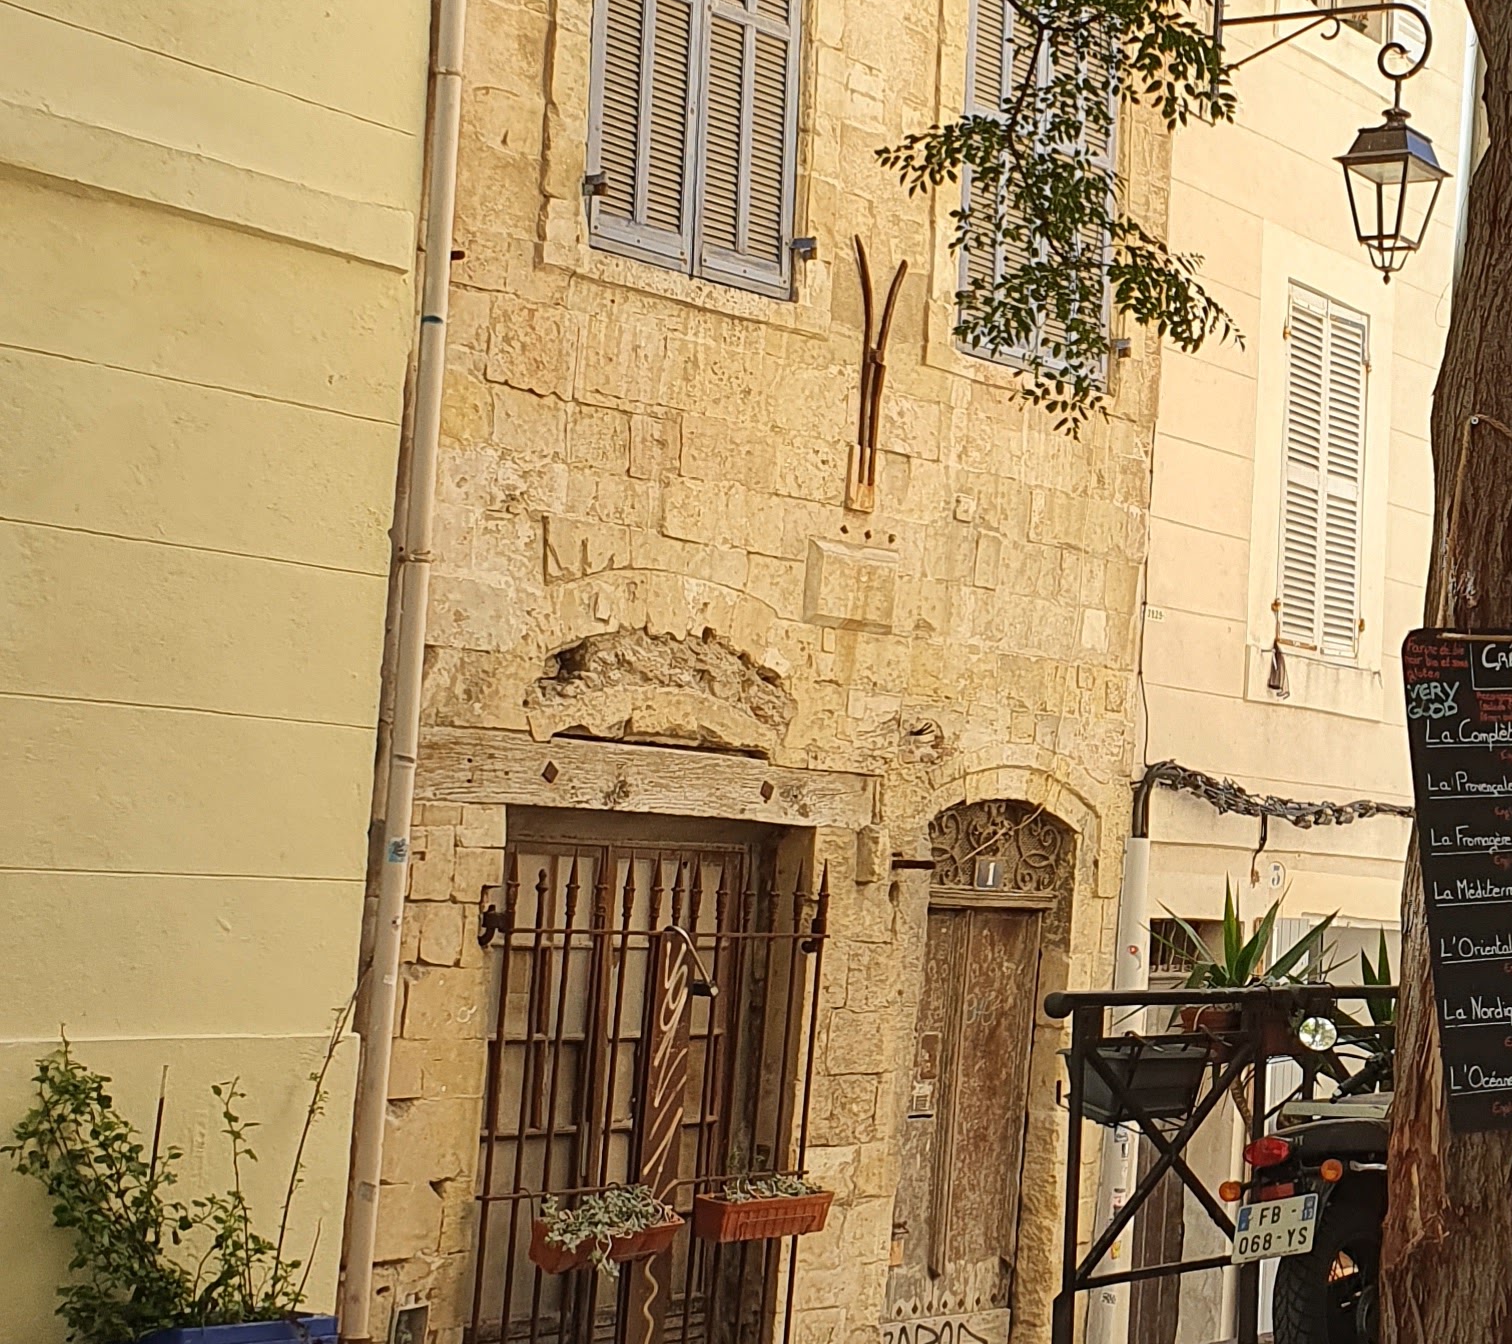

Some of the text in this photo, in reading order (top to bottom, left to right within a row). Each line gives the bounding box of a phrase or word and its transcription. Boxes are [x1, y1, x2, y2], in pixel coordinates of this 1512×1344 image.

[1407, 682, 1459, 700] VERY
[1408, 702, 1458, 718] GOOD
[1426, 719, 1454, 743] La
[1428, 773, 1451, 790] La
[1431, 828, 1452, 846] La
[1434, 881, 1454, 899] La
[1444, 999, 1467, 1020] La
[1238, 1226, 1308, 1255] 068-YS
